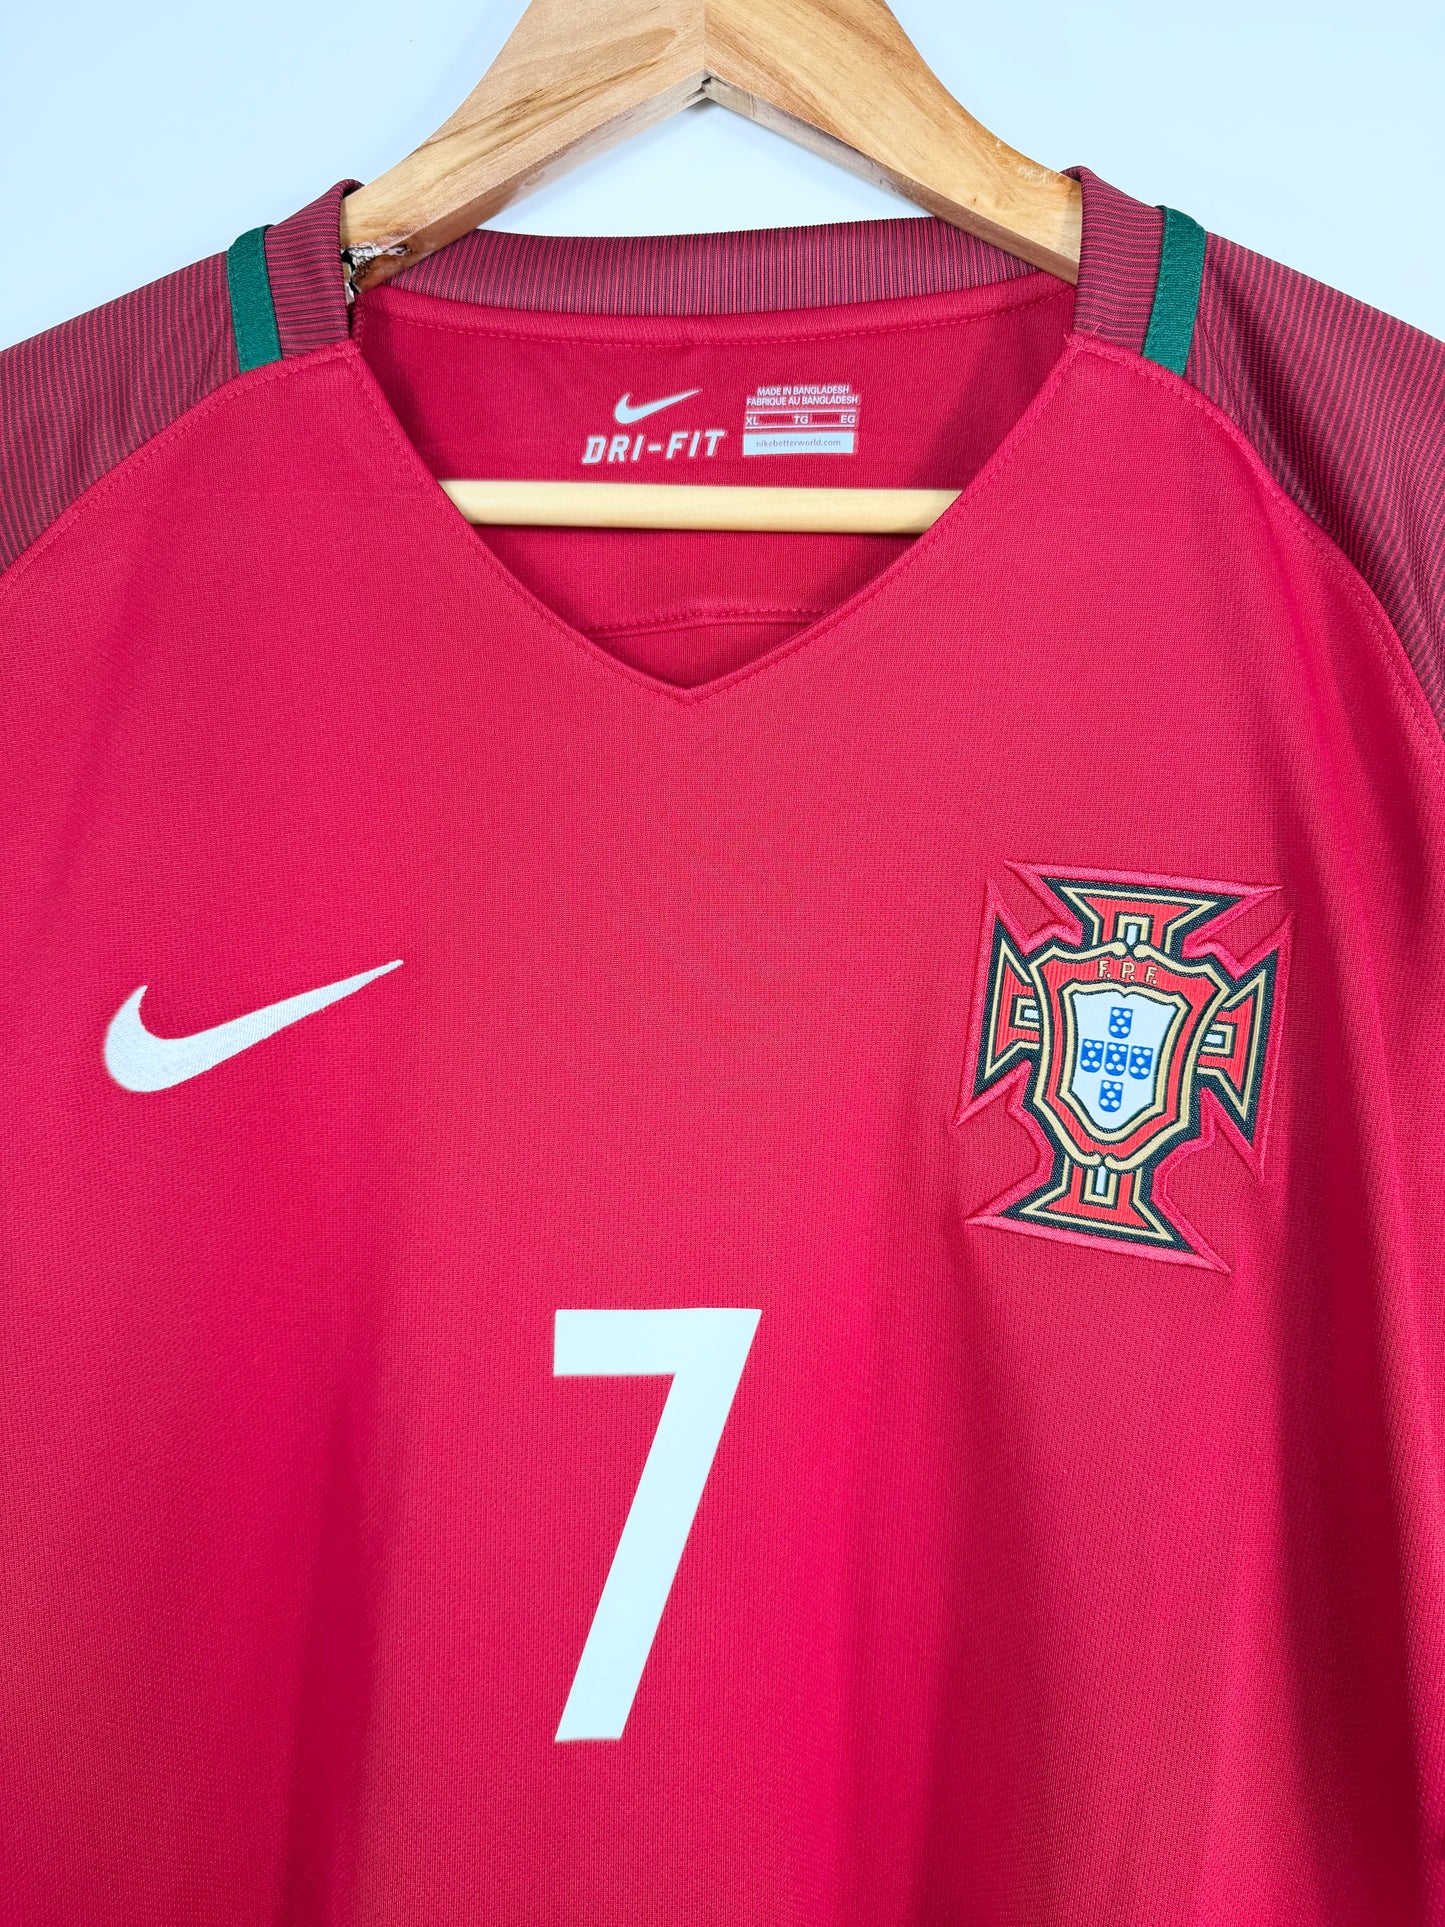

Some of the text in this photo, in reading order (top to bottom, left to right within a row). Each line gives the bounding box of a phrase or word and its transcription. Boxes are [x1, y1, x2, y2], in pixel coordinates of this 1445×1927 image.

[757, 385, 849, 396] MADE IN BANGLADESH
[746, 395, 858, 406] FABRIQUE AU BANGLADESH
[745, 414, 855, 425] XL TG EG
[582, 430, 725, 465] DRI-FIT
[756, 438, 841, 448] nikebetterworld.com
[554, 1308, 762, 1741] 7
